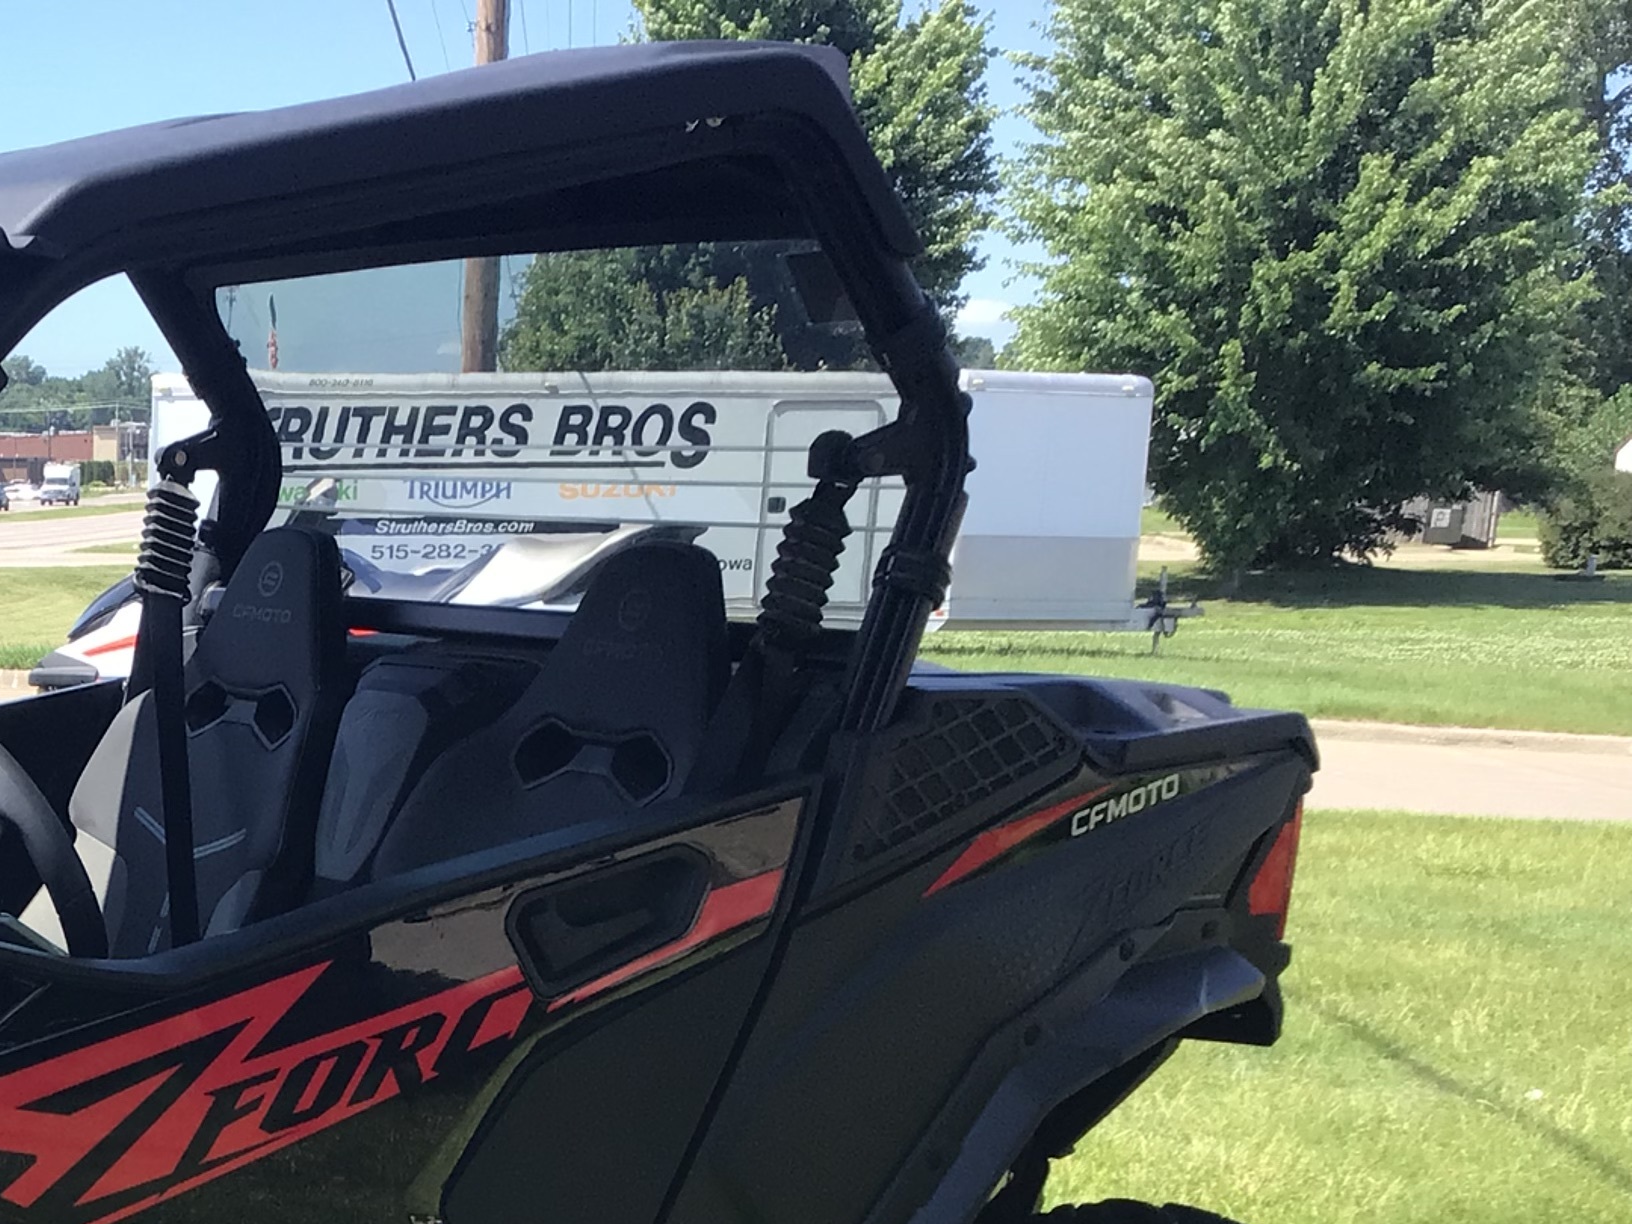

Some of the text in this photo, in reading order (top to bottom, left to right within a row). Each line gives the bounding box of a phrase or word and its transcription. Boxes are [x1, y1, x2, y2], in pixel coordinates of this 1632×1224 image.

[268, 401, 717, 469] RUTHERS BROS
[403, 480, 512, 501] TRIUMPH
[558, 482, 677, 500] SUZUKI
[374, 519, 535, 535] StruthersBros.com
[718, 555, 754, 571] owa
[1071, 773, 1180, 837] CFMOTO
